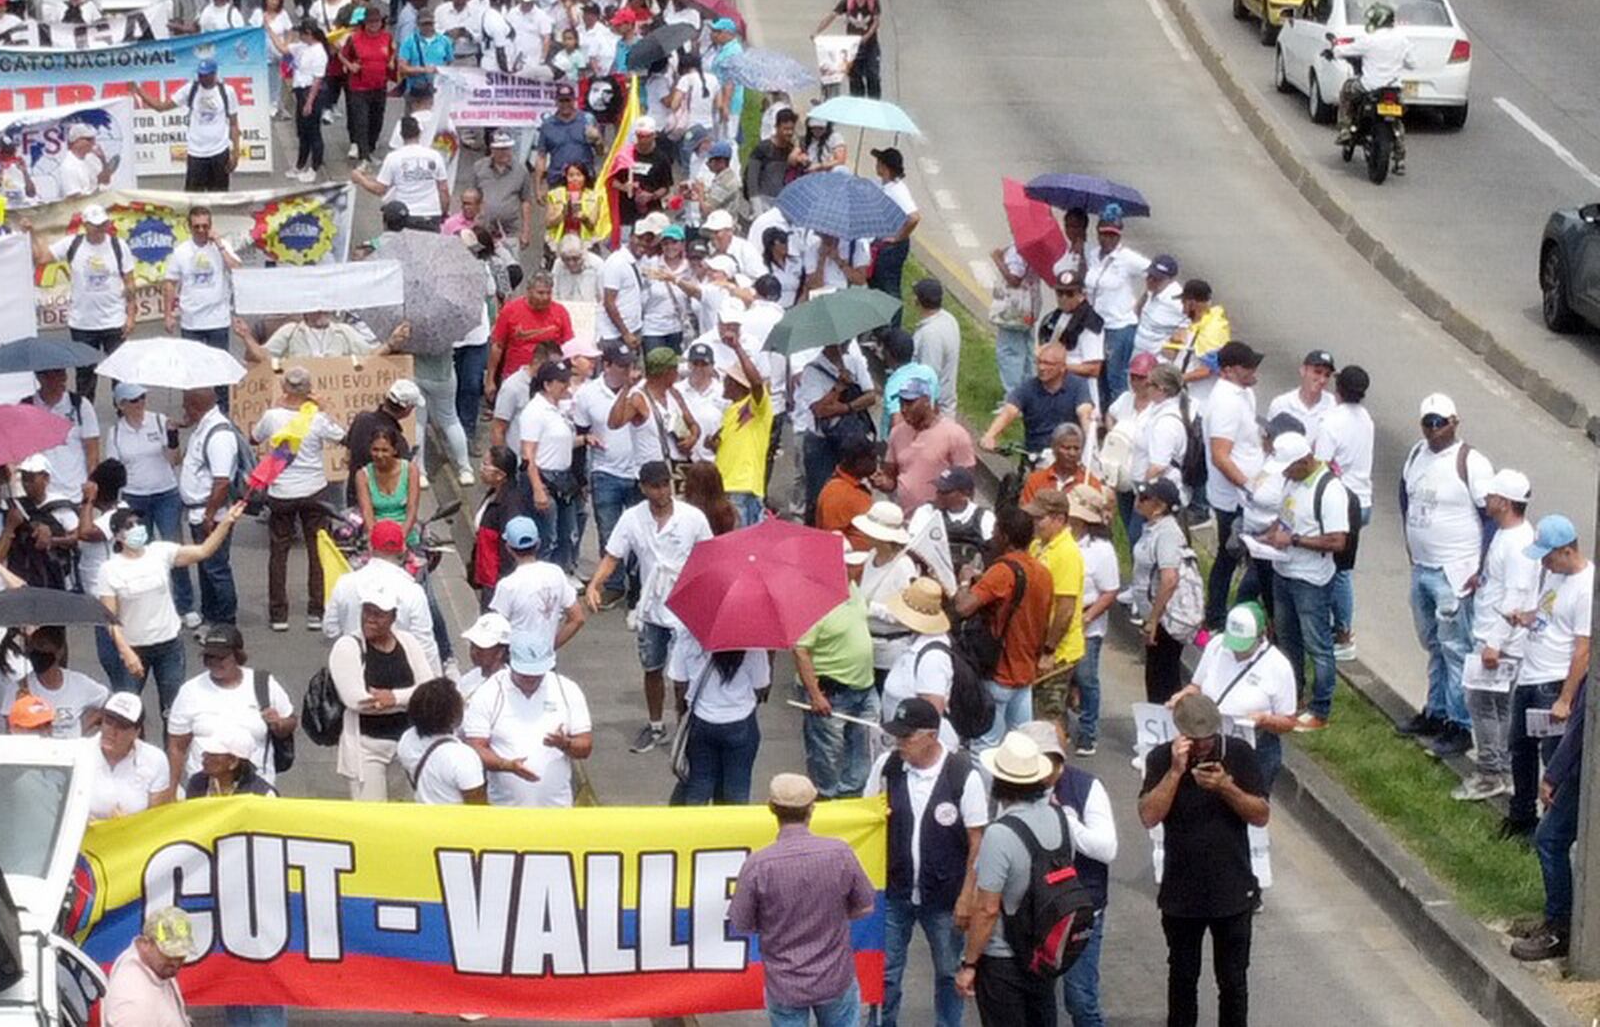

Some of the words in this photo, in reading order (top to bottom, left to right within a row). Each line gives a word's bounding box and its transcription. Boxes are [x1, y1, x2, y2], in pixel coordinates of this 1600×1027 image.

[63, 47, 177, 70] NACIONAL
[317, 373, 372, 391] NUEVO
[142, 831, 355, 967] CUT
[436, 847, 752, 977] VALLE
